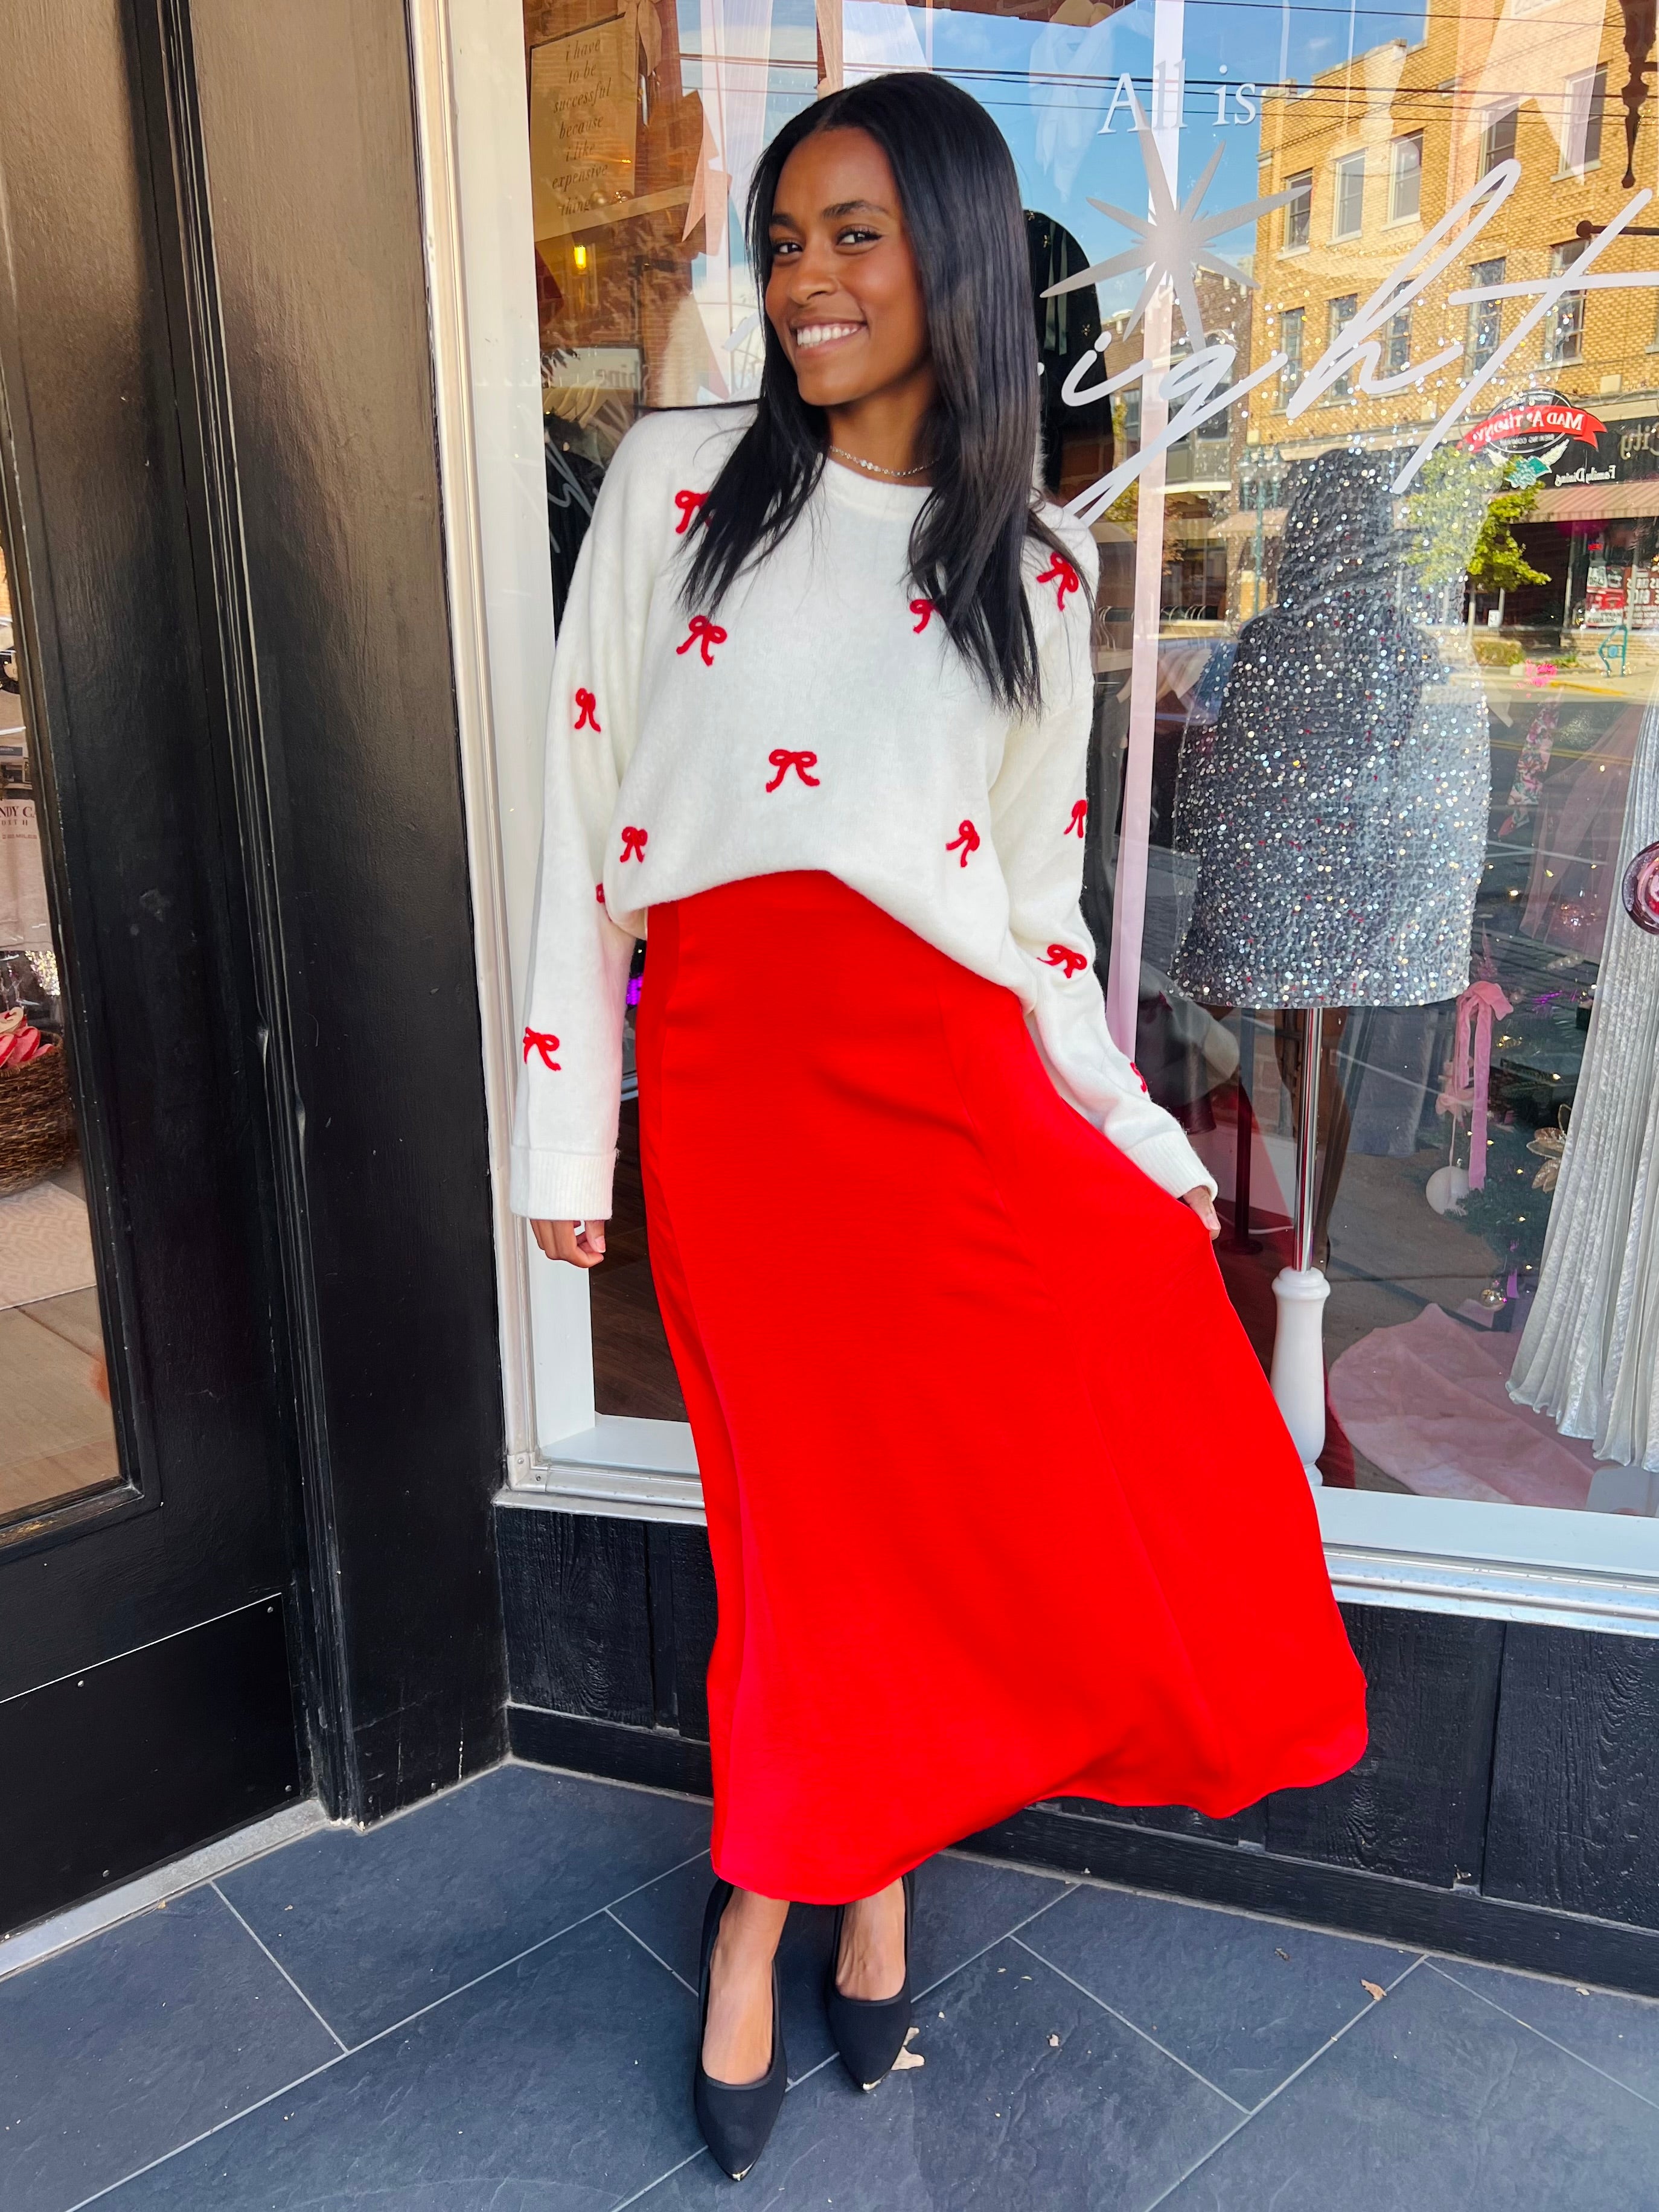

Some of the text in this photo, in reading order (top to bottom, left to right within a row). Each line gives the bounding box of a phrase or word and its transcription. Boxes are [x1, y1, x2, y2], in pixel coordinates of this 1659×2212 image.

[565, 39, 601, 62] i have
[568, 60, 596, 84] to be
[554, 77, 612, 113] successful
[1097, 58, 1256, 135] All is
[559, 116, 604, 139] because
[565, 140, 595, 162] i like
[552, 164, 609, 193] expensive
[560, 196, 594, 217] thing
